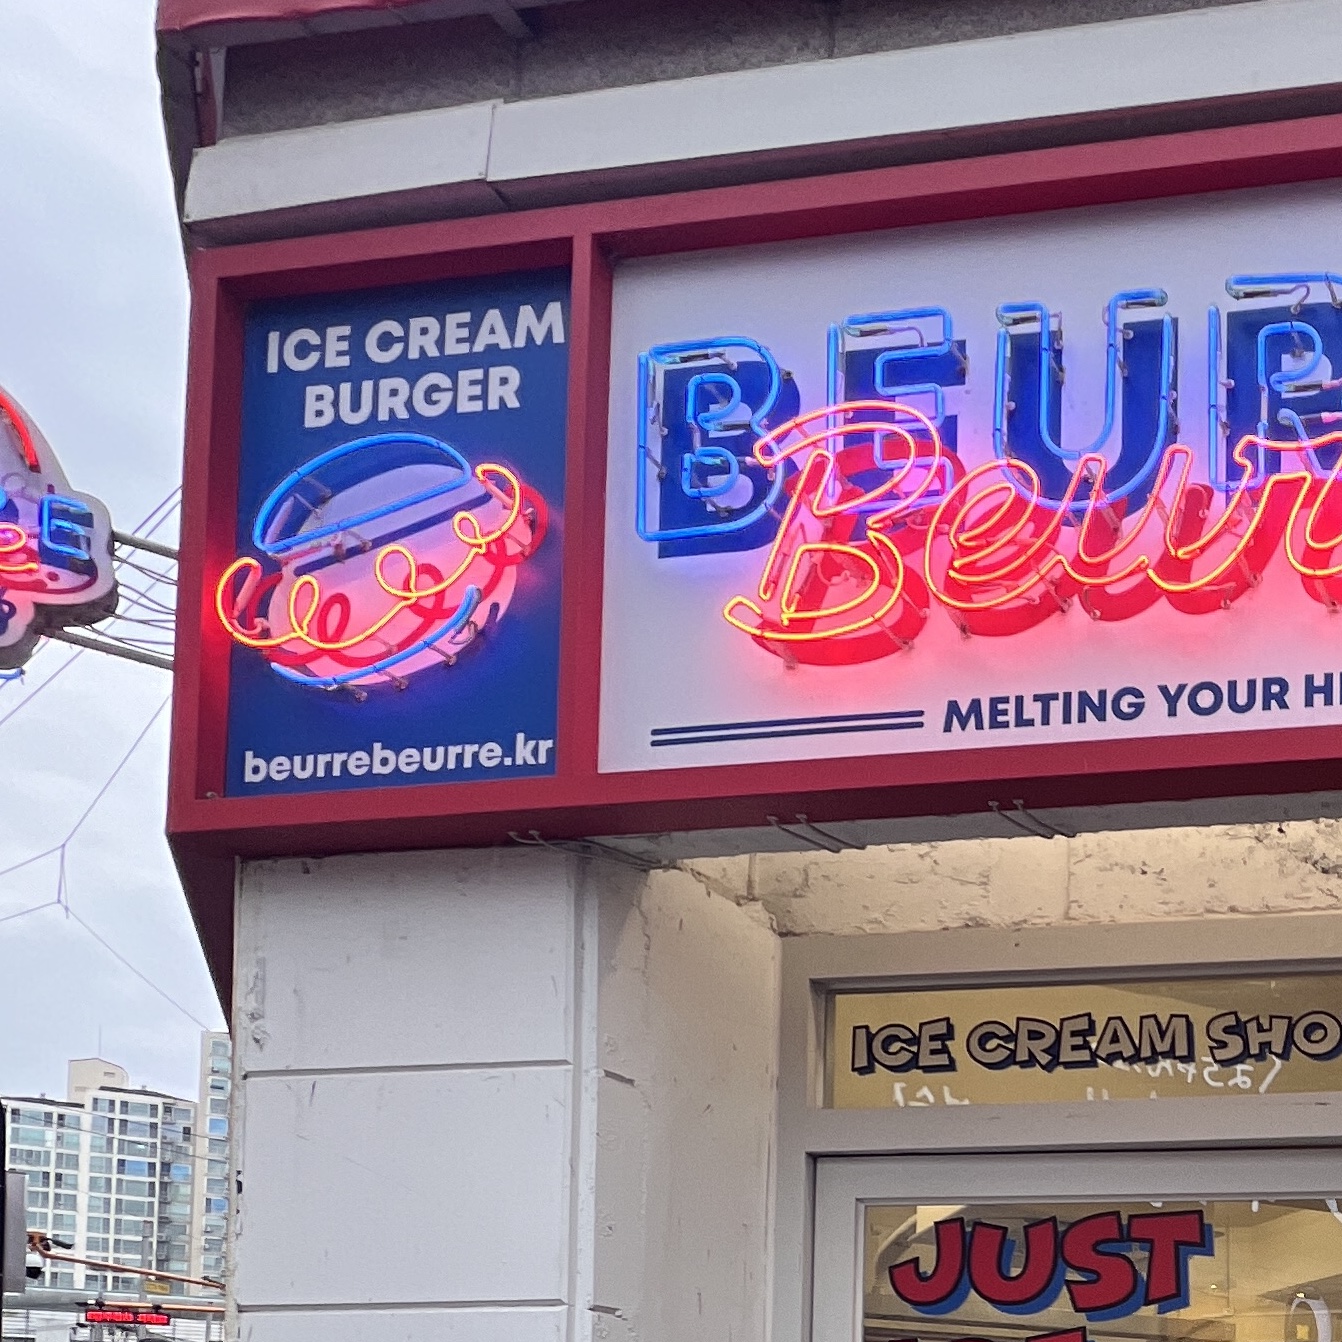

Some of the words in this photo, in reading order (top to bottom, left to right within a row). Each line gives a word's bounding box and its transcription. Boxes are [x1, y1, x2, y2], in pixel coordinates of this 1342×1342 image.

[266, 325, 351, 374] ICE
[364, 301, 567, 365] CREAM
[302, 364, 522, 429] BURGER
[943, 685, 1146, 733] MELTING
[1158, 676, 1291, 718] YOUR
[243, 731, 555, 784] beurrebeurre.kr
[850, 1015, 956, 1075] ICE
[965, 1011, 1195, 1073] CREAM
[888, 1210, 1215, 1323] JUST
